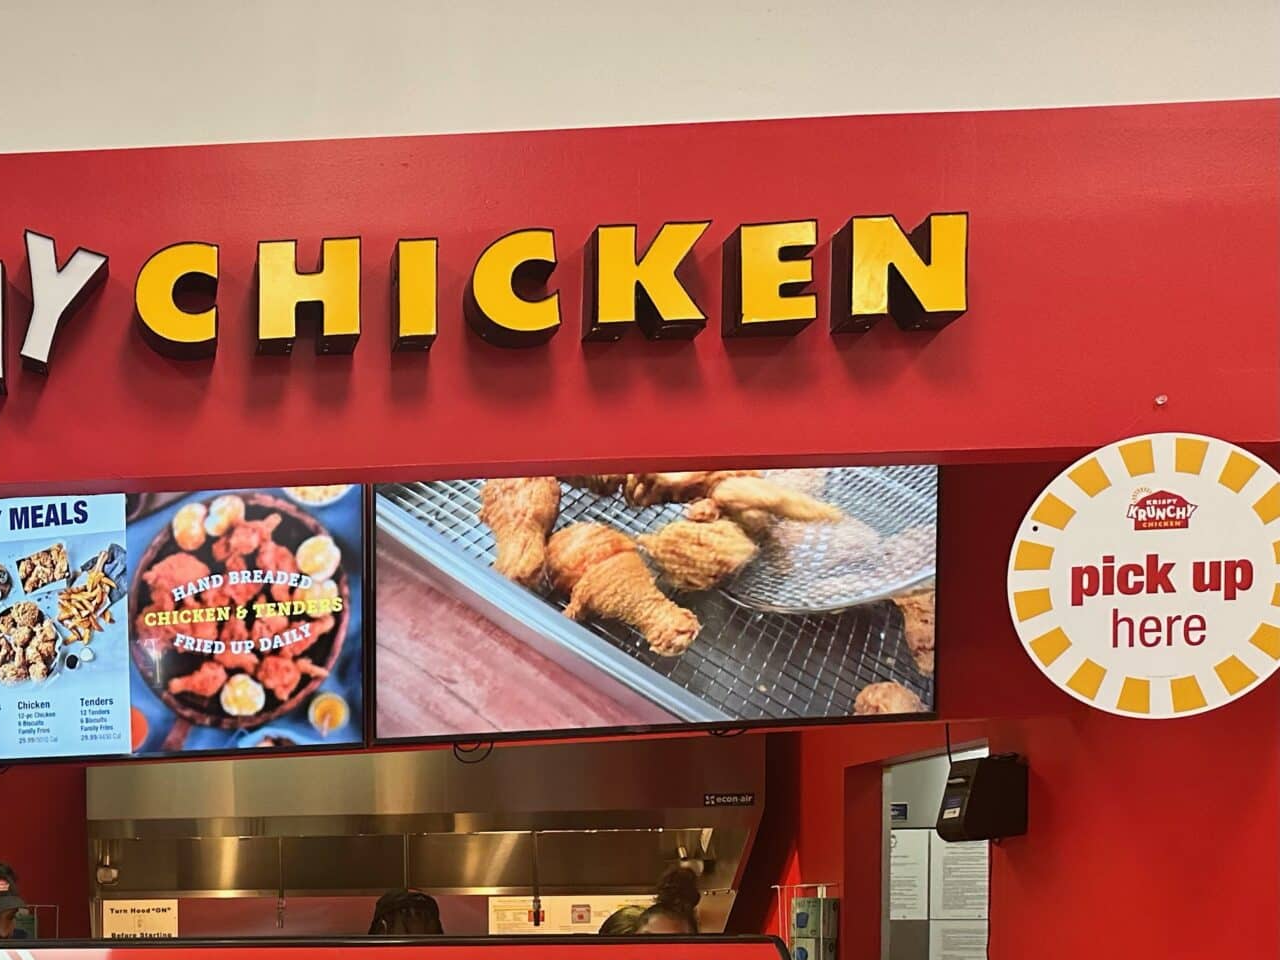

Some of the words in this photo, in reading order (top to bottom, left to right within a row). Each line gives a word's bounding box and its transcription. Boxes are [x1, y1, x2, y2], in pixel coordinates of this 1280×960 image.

[134, 211, 969, 346] CHICKEN
[9, 500, 88, 530] MEALS
[1127, 503, 1198, 522] KRUNCHY
[1142, 520, 1182, 528] CHICKEN
[172, 574, 224, 601] HAND
[228, 570, 313, 589] BREADED
[1071, 554, 1176, 606] pick
[1192, 558, 1254, 600] up
[144, 606, 231, 628] CHICKEN
[236, 608, 249, 620] &
[253, 596, 343, 619] TENDERS
[173, 633, 226, 655] FRIED
[231, 640, 256, 655] UP
[259, 623, 313, 652] DAILY
[1112, 608, 1207, 648] here
[18, 701, 51, 711] Chicken
[80, 697, 114, 707] Tenders
